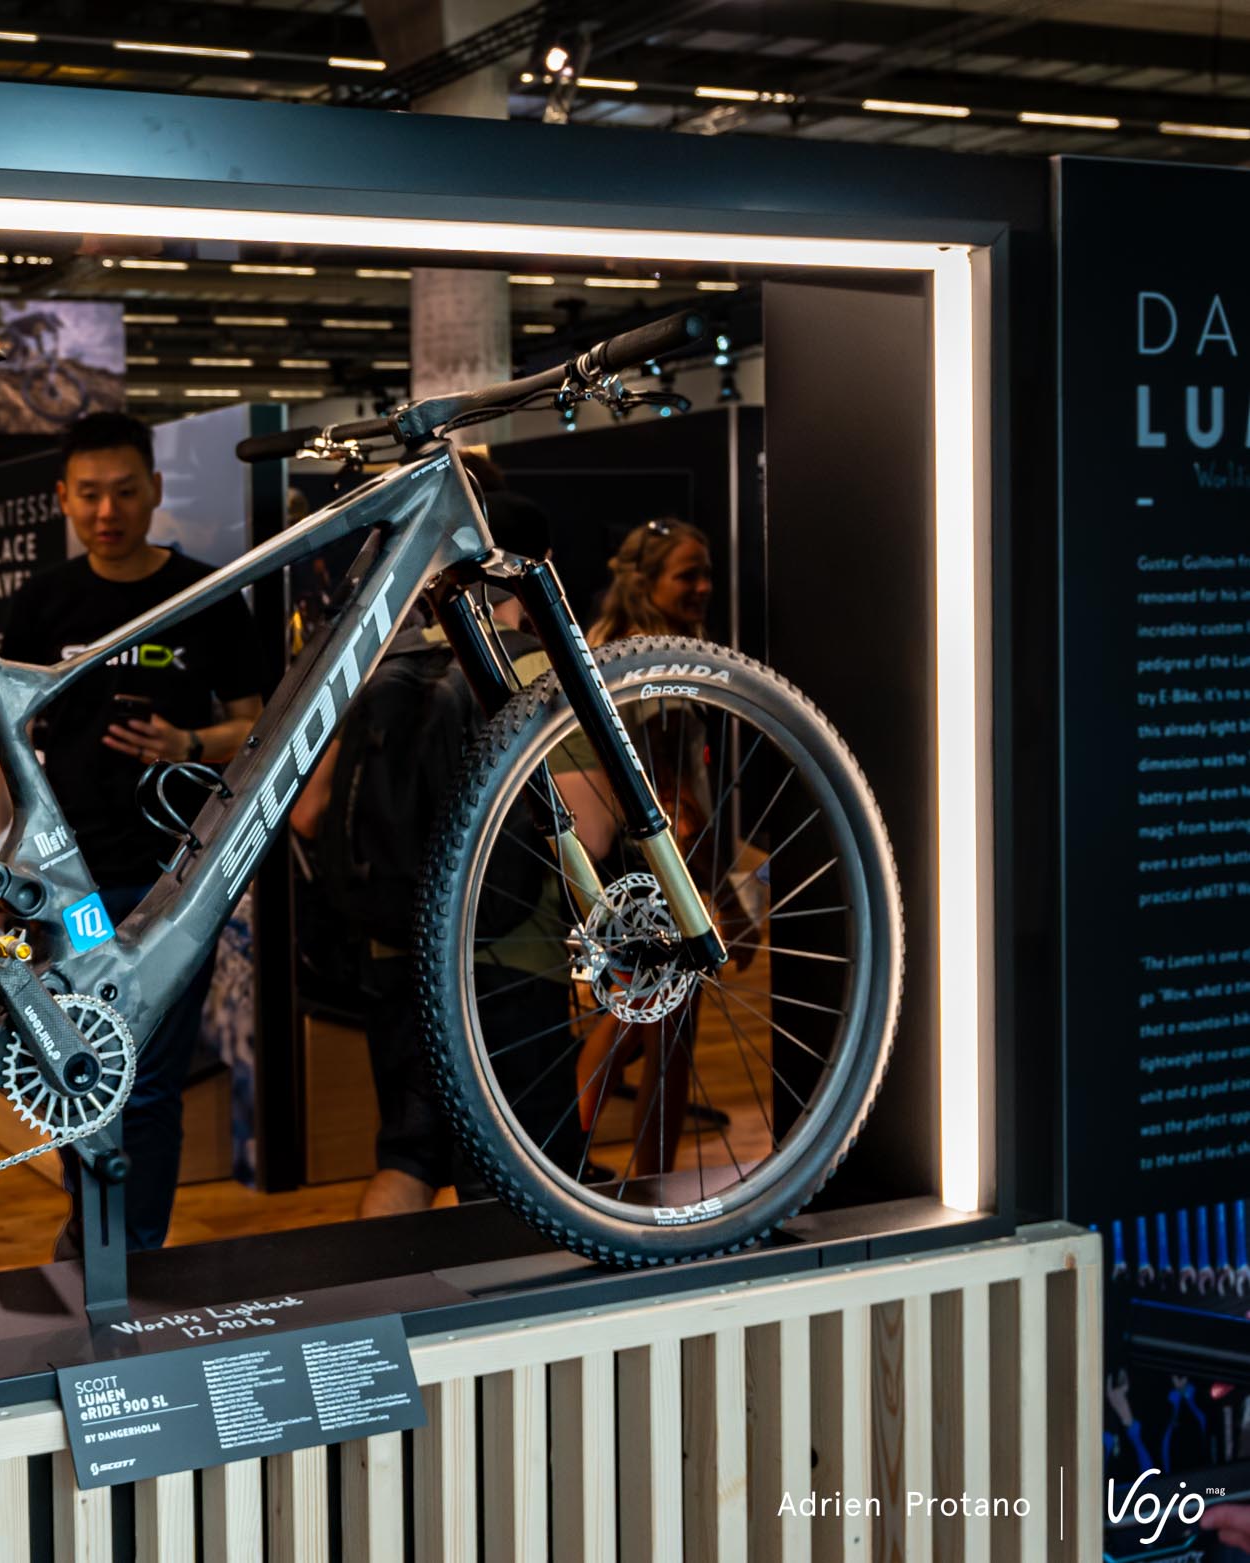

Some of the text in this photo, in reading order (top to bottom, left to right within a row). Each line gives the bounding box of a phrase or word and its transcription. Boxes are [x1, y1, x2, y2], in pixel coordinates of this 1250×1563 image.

[1136, 384, 1250, 450] LU
[1136, 588, 1197, 605] renowned
[1199, 586, 1218, 603] for
[1220, 586, 1238, 602] his
[1136, 621, 1198, 638] incredible
[1200, 622, 1244, 637] custom
[622, 664, 732, 684] KENDA
[1136, 656, 1191, 675] pedigree
[1193, 654, 1207, 669] of
[1210, 655, 1230, 669] the
[1136, 690, 1156, 709] try
[1225, 688, 1241, 701] no
[221, 571, 395, 900] SCOTT
[1137, 723, 1161, 739] this
[1163, 721, 1207, 739] already
[1209, 719, 1237, 737] light
[1137, 755, 1200, 773] dimension
[1202, 755, 1224, 768] was
[1226, 752, 1246, 768] the
[1137, 789, 1183, 806] battery
[1185, 787, 1207, 803] and
[1210, 786, 1238, 800] even
[1137, 823, 1175, 842] magic
[1177, 819, 1207, 836] from
[1137, 858, 1168, 873] even
[1171, 857, 1178, 870] a
[1180, 852, 1222, 869] carbon
[1137, 885, 1192, 909] practical
[70, 903, 108, 938] TQ
[1167, 952, 1204, 970] Lumen
[1207, 949, 1217, 965] is
[1218, 949, 1240, 964] one
[1193, 983, 1222, 999] what
[1225, 982, 1233, 996] a
[1139, 1022, 1165, 1039] that
[1167, 1022, 1176, 1036] a
[1177, 1015, 1231, 1034] mountain
[1139, 1050, 1203, 1073] lightweight
[1205, 1048, 1229, 1063] now
[1166, 1084, 1188, 1101] and
[1190, 1085, 1198, 1098] a
[1200, 1078, 1229, 1100] good
[1139, 1123, 1163, 1138] was
[1165, 1119, 1184, 1134] the
[1186, 1111, 1227, 1134] perfect
[1139, 1155, 1154, 1171] to
[1155, 1152, 1175, 1169] the
[1177, 1148, 1203, 1165] next
[653, 1197, 723, 1219] DUKE
[111, 1314, 201, 1335] World's
[74, 1375, 118, 1395] SCOTT
[77, 1388, 126, 1408] LUMEN
[80, 1394, 169, 1421] eRIDE 900 SL
[85, 1423, 161, 1444] BY DANGERHOLM
[99, 1458, 136, 1472] SCOTT
